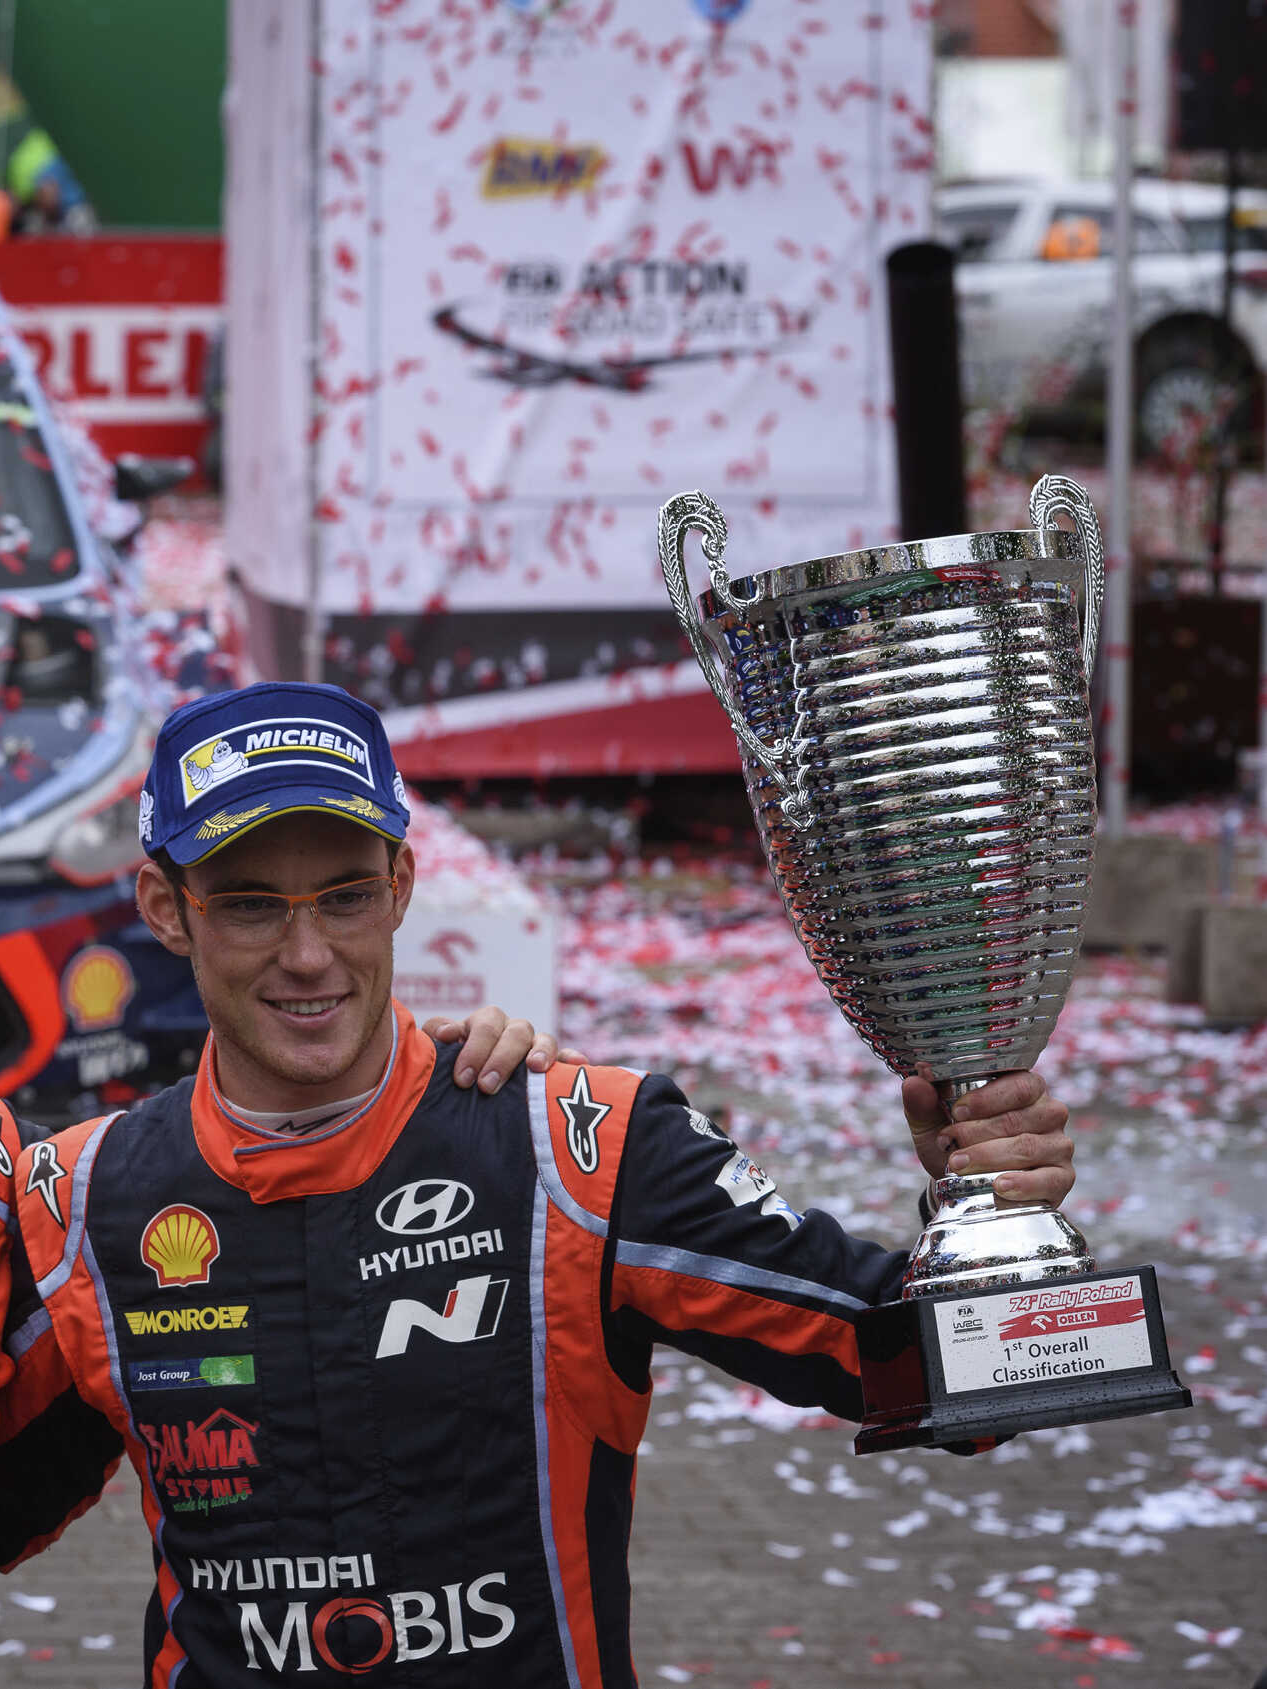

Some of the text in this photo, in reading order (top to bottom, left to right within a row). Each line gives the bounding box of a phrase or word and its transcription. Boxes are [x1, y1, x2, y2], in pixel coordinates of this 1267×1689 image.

[581, 262, 747, 295] ACTION
[245, 729, 366, 765] MICHELIN
[359, 1228, 504, 1281] HYUNDAI
[1038, 1290, 1078, 1310] Rally
[1077, 1281, 1133, 1304] Poland
[139, 1306, 232, 1334] MONROE
[1059, 1312, 1095, 1325] ORLEN
[1004, 1336, 1089, 1361] 1st Overall
[138, 1370, 190, 1381] Jost Group
[993, 1357, 1105, 1383] Classification
[190, 1553, 376, 1590] HYUNDAI
[238, 1572, 516, 1674] MOBIS
